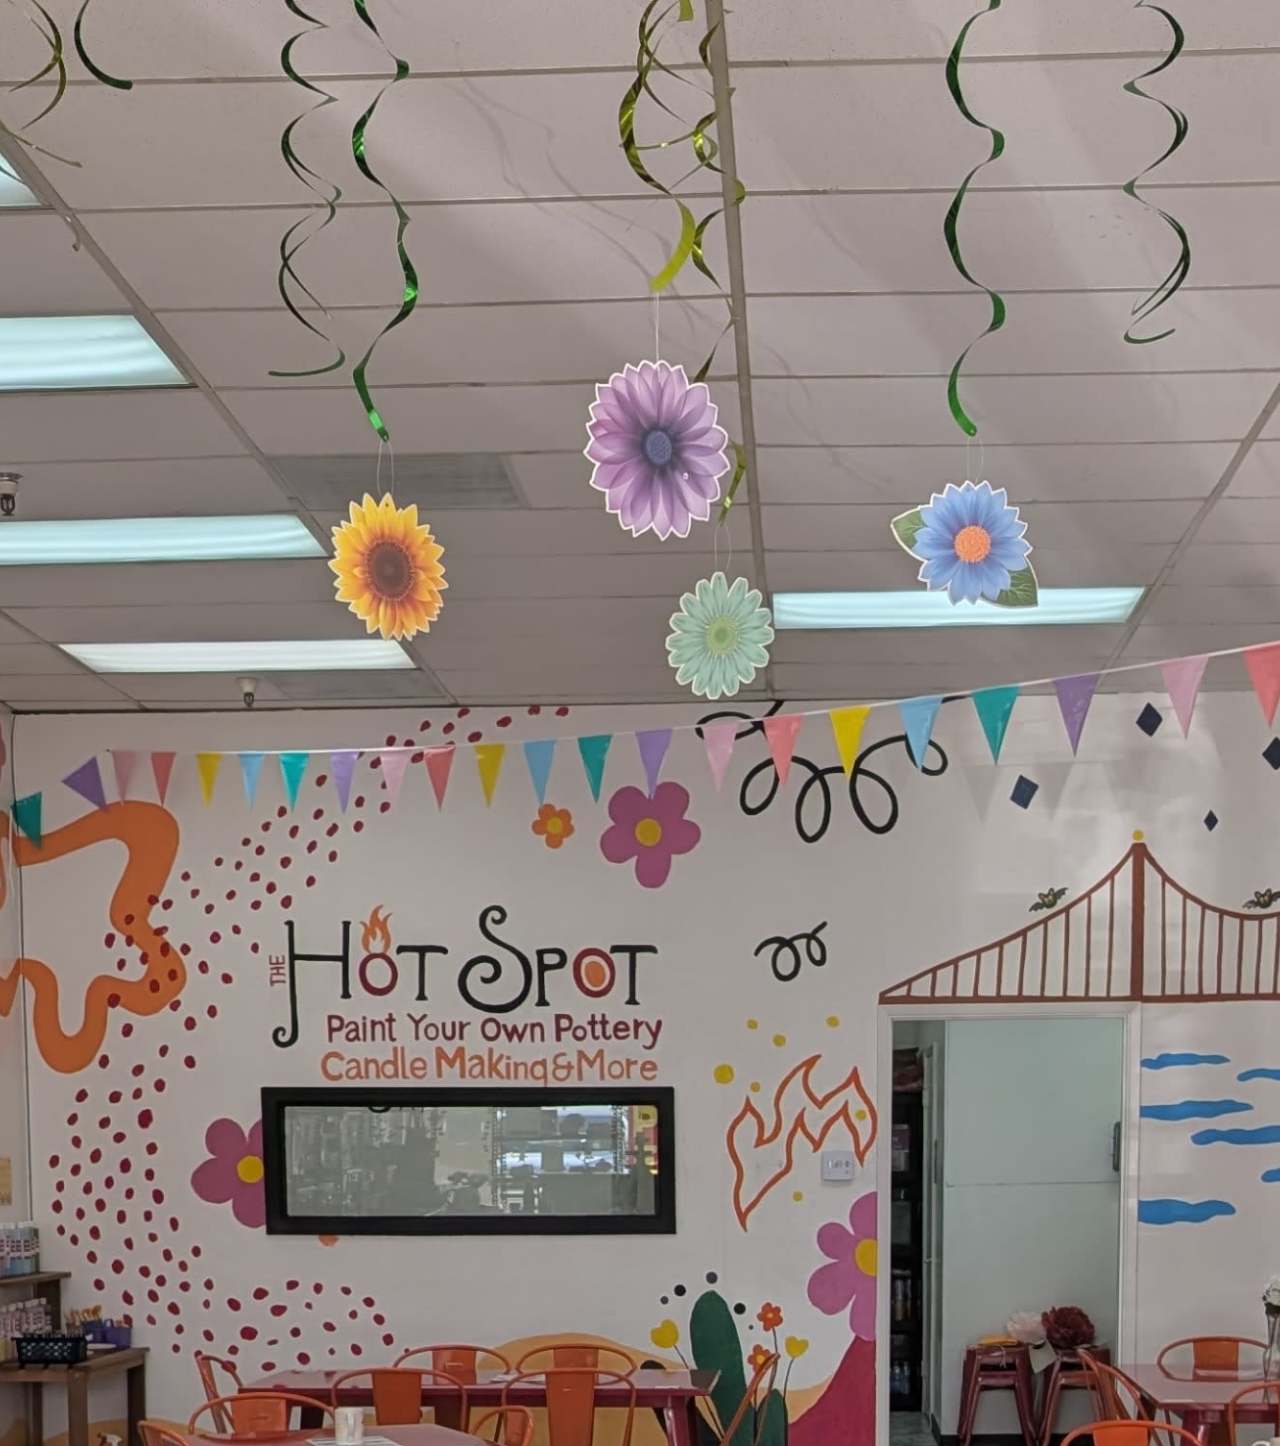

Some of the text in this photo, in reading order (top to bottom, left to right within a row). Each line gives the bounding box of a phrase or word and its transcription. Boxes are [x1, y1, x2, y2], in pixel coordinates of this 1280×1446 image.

[268, 904, 659, 1048] THE HOT SPOT
[326, 1012, 663, 1050] Paint Your Own Pottery
[320, 1046, 427, 1082] Candle
